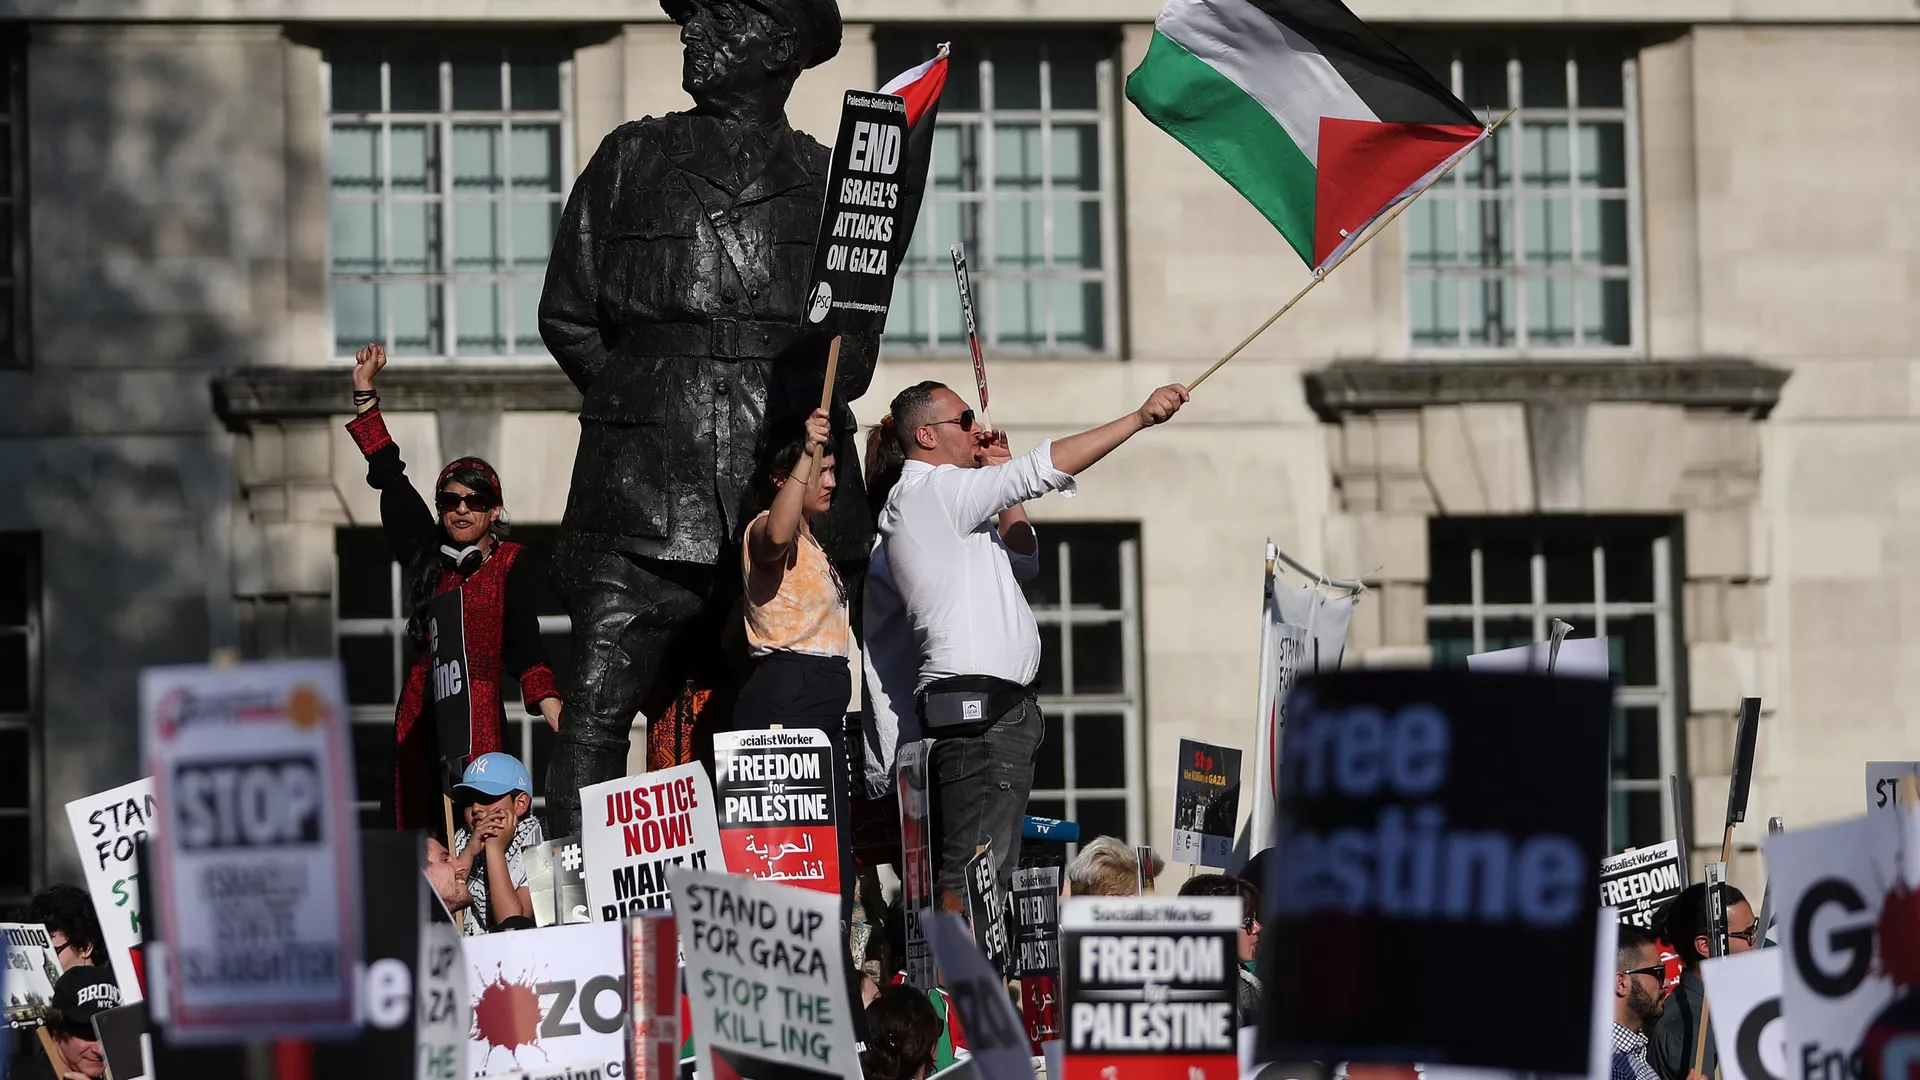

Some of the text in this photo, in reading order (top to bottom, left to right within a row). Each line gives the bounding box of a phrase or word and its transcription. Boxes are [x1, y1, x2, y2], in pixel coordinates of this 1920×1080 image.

[847, 94, 871, 108] Palestine
[871, 97, 894, 113] Solidarity
[848, 121, 901, 175] END
[839, 178, 899, 209] ISRAEL'S
[832, 211, 894, 243] ATTACKS
[826, 244, 887, 276] ON GAZA
[815, 295, 831, 309] PSC
[429, 617, 439, 652] e
[732, 734, 814, 747] ocialist Worker
[727, 753, 821, 782] FREEDOM
[606, 776, 698, 827] JUSTICE
[768, 781, 786, 794] for
[179, 764, 316, 846] STOP
[725, 794, 829, 823] PALESTINE
[623, 812, 694, 857] NOW!
[1036, 825, 1050, 834] TV
[745, 832, 814, 861] الحرية
[1600, 848, 1668, 875] Socialist Worker
[612, 855, 684, 901] MAK
[1600, 864, 1680, 907] FREEDOM
[686, 882, 823, 942] STAND UP
[1091, 905, 1161, 922] Socialist
[1637, 897, 1652, 911] for
[692, 919, 828, 985] FOR GAZA
[1079, 935, 1225, 983] FREEDOM
[702, 968, 833, 1025] STOP THE
[714, 1007, 832, 1065] KILLING
[1070, 1001, 1233, 1050] PALESTINE
